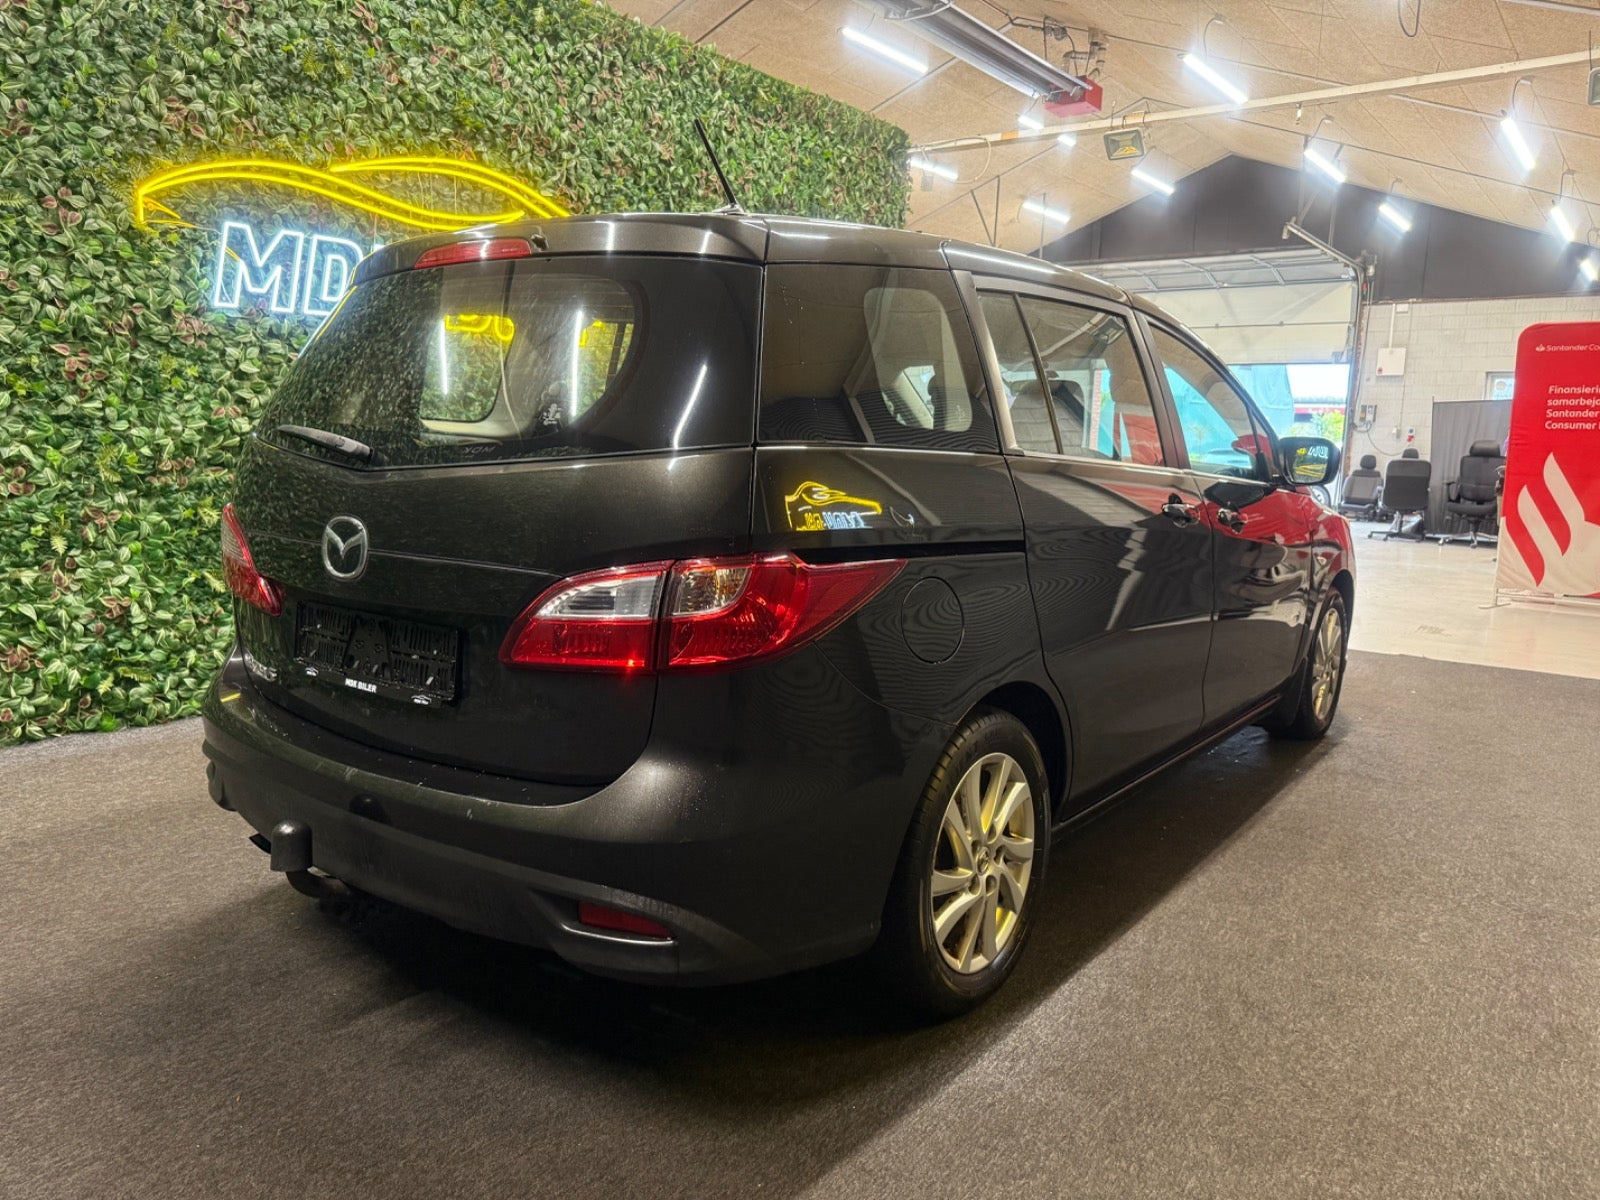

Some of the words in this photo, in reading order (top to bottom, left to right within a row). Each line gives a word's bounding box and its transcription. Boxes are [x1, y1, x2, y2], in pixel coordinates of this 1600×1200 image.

[213, 221, 385, 316] MD
[1546, 409, 1599, 417] Santander
[1545, 421, 1597, 429] Consumer
